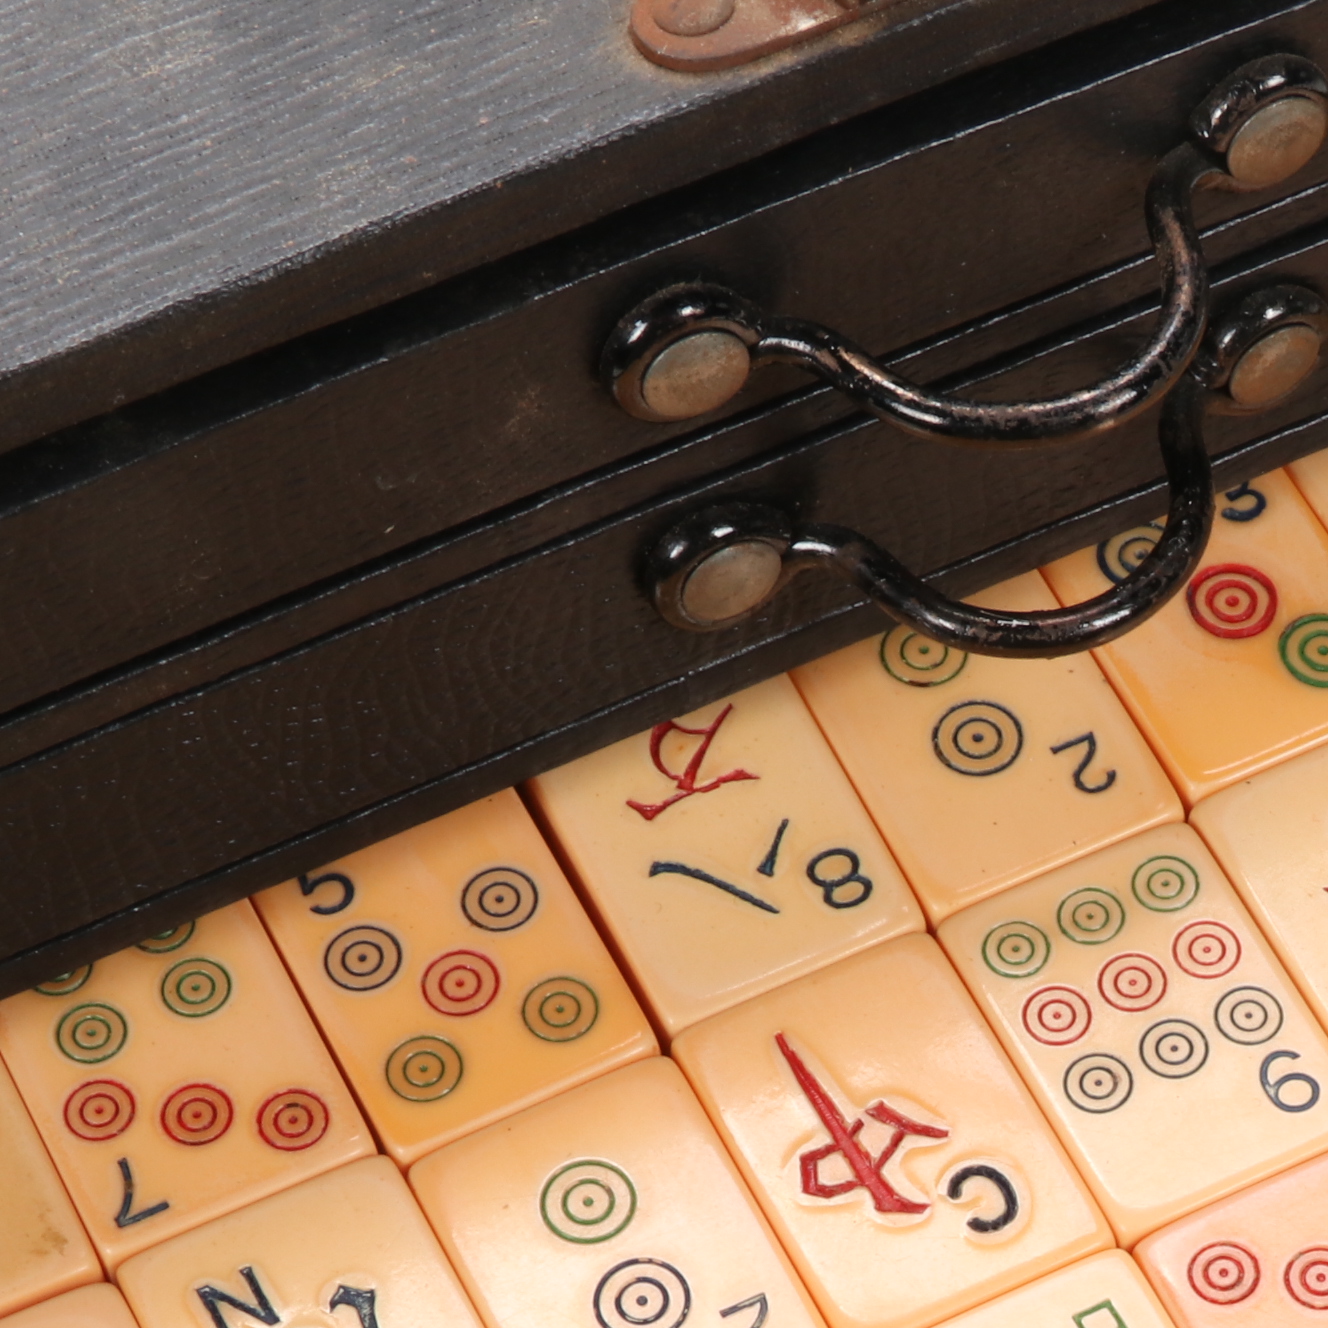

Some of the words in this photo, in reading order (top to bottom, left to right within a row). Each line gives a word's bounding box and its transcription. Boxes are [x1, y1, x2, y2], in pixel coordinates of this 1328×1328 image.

[1049, 731, 1117, 794] 2
[805, 847, 874, 910] 8
[774, 1030, 950, 1216] 中
[113, 1157, 170, 1229] 7
[947, 1165, 1018, 1233] C
